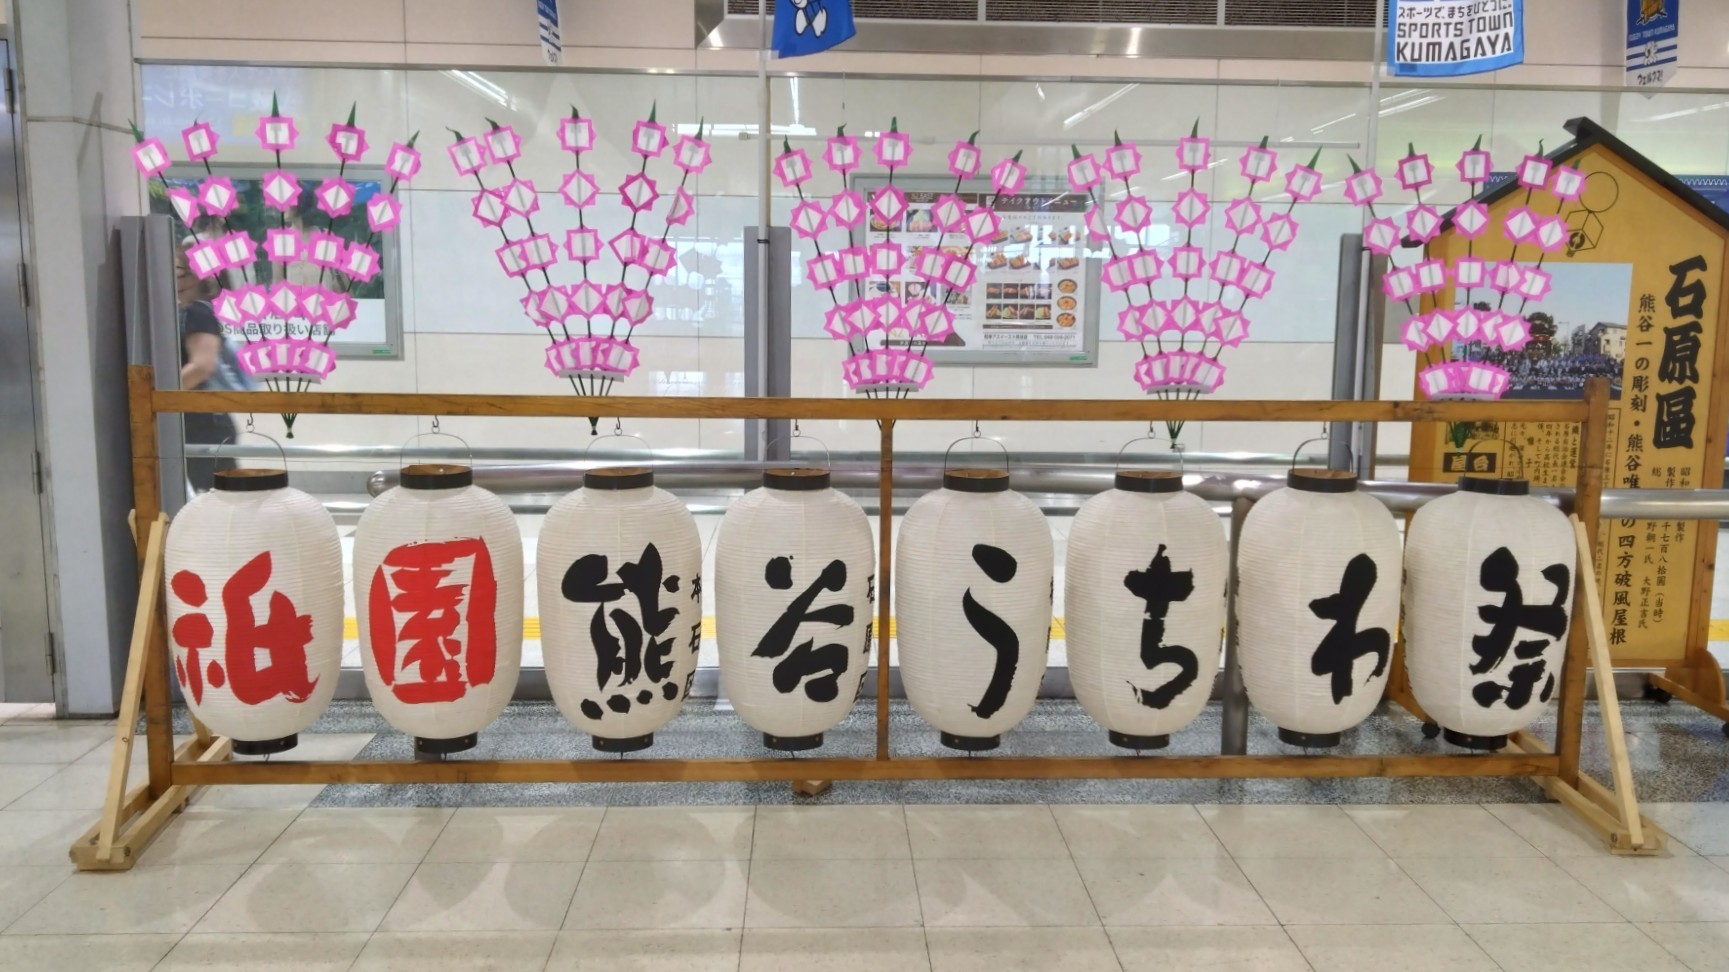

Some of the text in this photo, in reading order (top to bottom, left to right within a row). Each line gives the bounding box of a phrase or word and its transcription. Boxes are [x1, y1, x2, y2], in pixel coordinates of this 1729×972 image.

[1396, 32, 1512, 62] KUMAGAYA
[1397, 11, 1513, 38] SPORTS TOWN
[561, 542, 680, 720] 熊
[751, 555, 855, 703] 谷
[963, 544, 1019, 719] う
[1124, 544, 1199, 710] ち
[1309, 553, 1391, 705] わ
[1469, 546, 1570, 711] 祭
